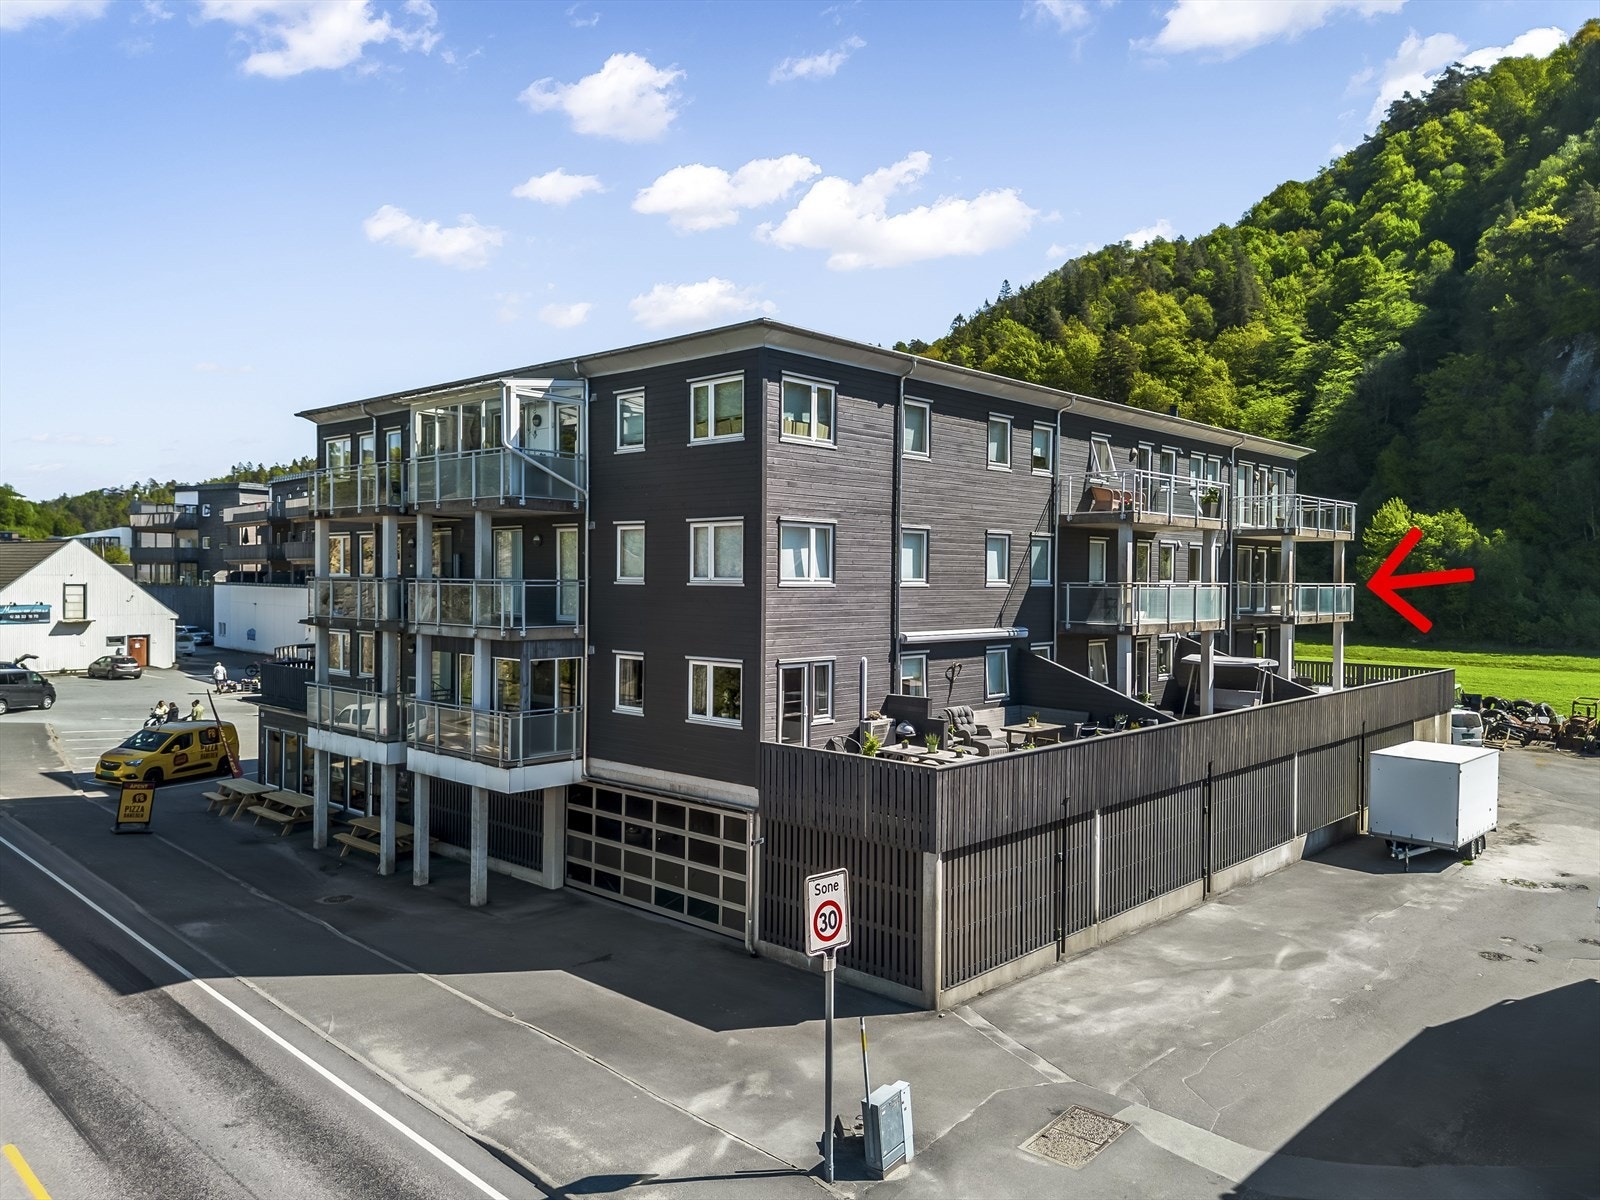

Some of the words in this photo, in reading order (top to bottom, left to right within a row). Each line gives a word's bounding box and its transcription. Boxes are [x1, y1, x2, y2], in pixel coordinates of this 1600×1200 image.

[124, 805, 145, 813] PIZZA
[815, 882, 839, 896] Sone
[820, 910, 837, 932] 30
